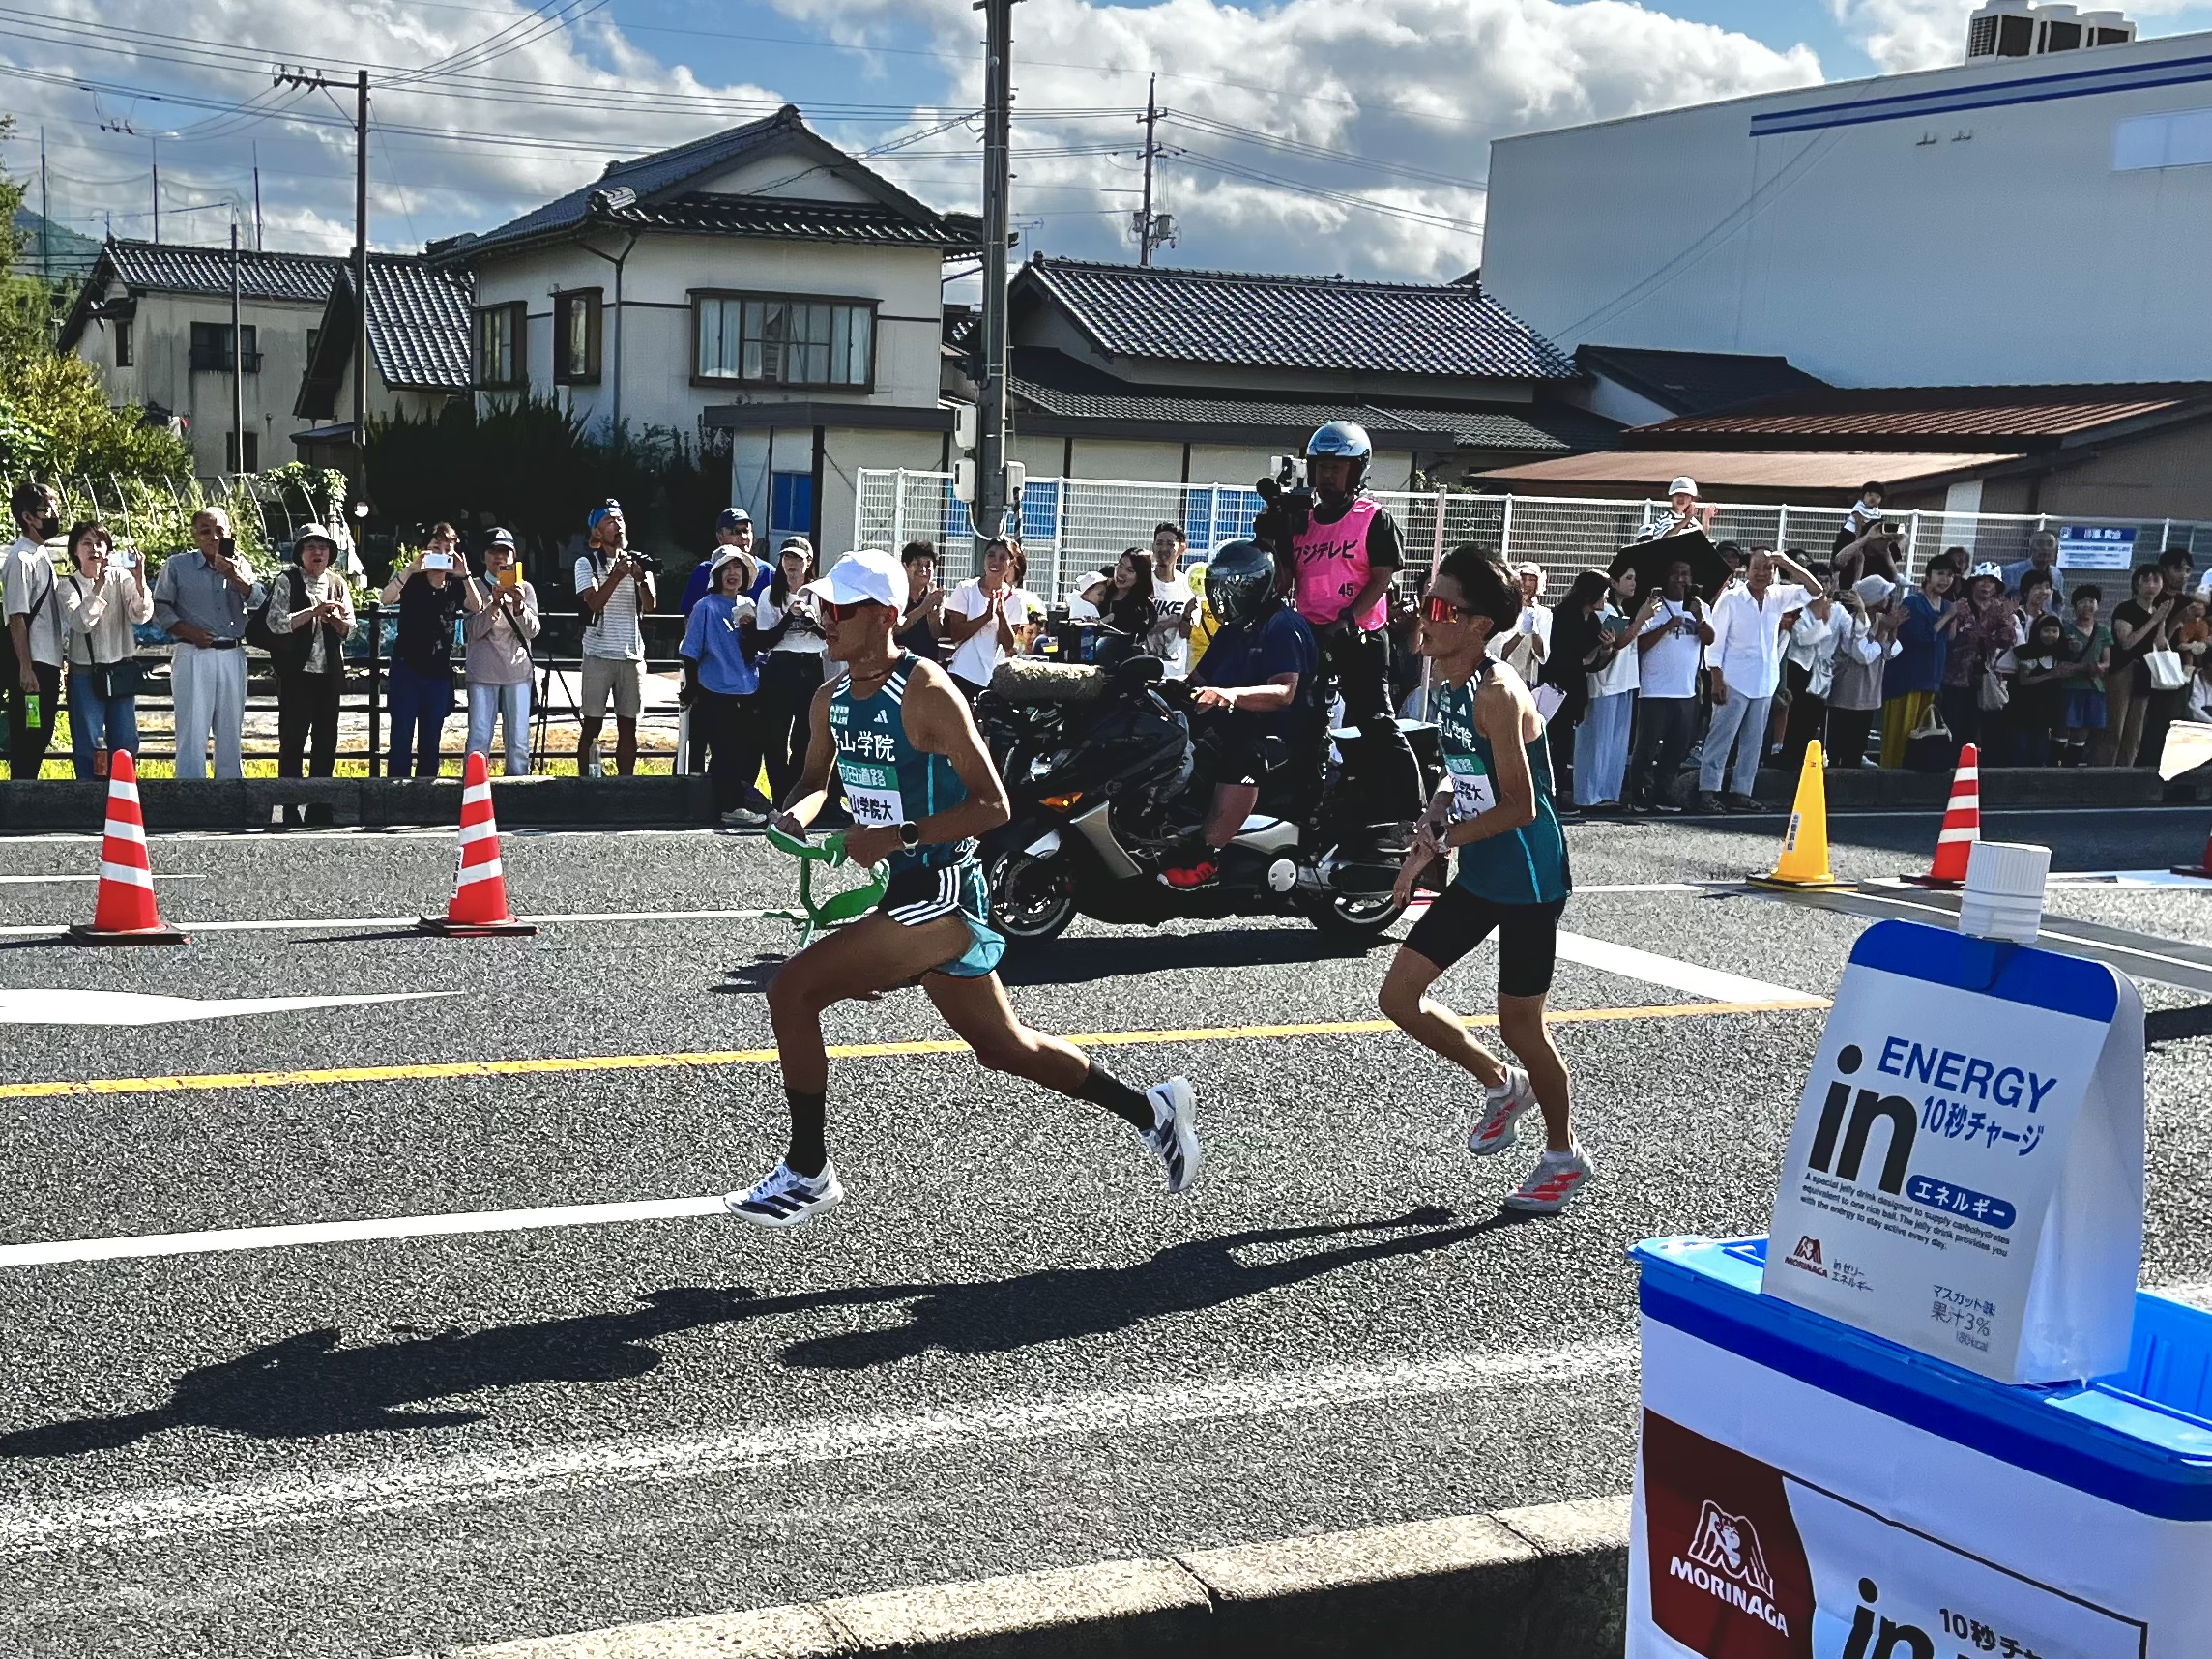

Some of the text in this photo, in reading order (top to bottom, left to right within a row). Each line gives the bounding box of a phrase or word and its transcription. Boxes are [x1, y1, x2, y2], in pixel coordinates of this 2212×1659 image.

[1338, 582, 1354, 597] 45
[1877, 1036, 2057, 1113] ENERGY
[1808, 1044, 1917, 1195] in
[1921, 1095, 2044, 1156] 10秒チャージ
[1856, 1212, 1865, 1222] to
[1914, 1207, 1922, 1216] to
[1915, 1181, 2006, 1218] エネルギー
[1841, 1196, 1849, 1205] to
[1992, 1246, 2008, 1258] you
[1784, 1256, 1828, 1278] MORINAGA
[1831, 1271, 1874, 1292] エネルギー
[1931, 1300, 1991, 1337] 果汁3%
[1670, 1555, 1789, 1637] MORINAGA
